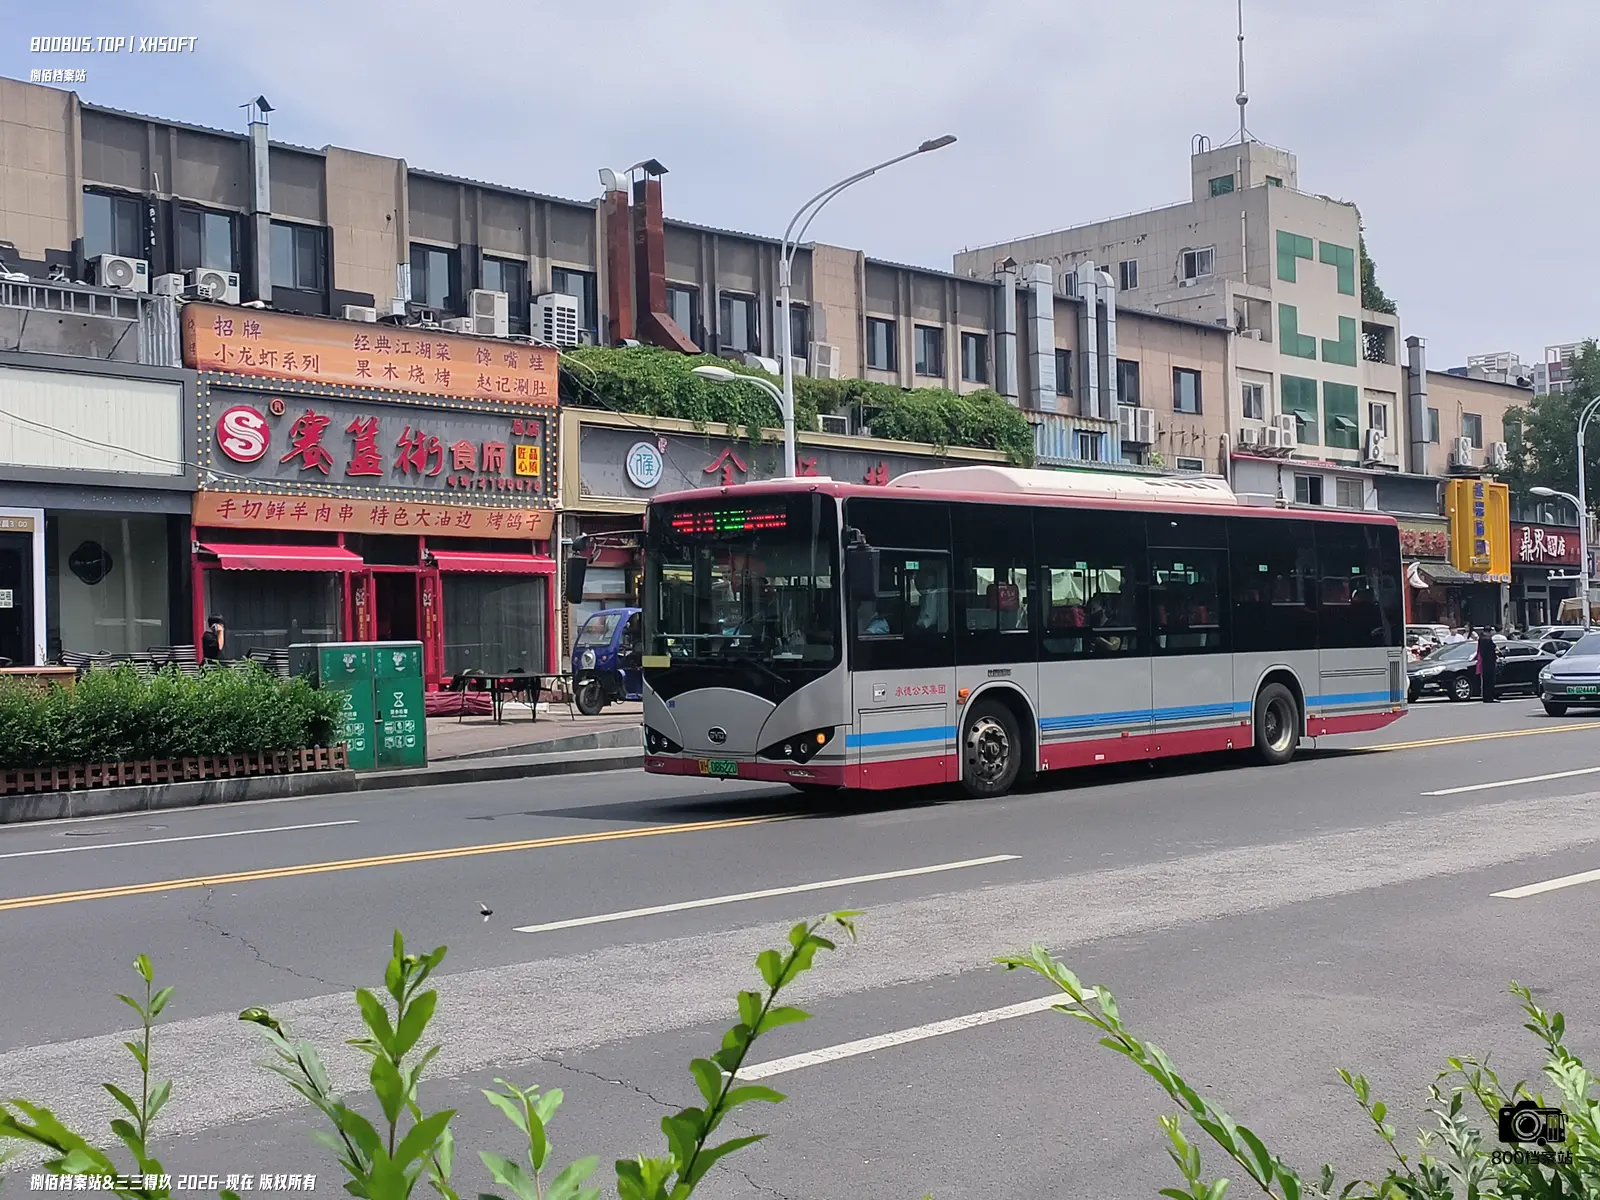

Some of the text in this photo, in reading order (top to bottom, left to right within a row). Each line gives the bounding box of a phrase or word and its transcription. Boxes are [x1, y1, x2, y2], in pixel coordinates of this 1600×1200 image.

[214, 315, 261, 340] 招牌
[214, 343, 319, 374] 小龙虾系列
[354, 334, 545, 371] 经典江湖菜 馋嘴蛙
[356, 359, 547, 396] 果木烧烤 赵记涮肚
[217, 498, 542, 532] 手切鲜羊肉串 特色大油边 烤鸽子
